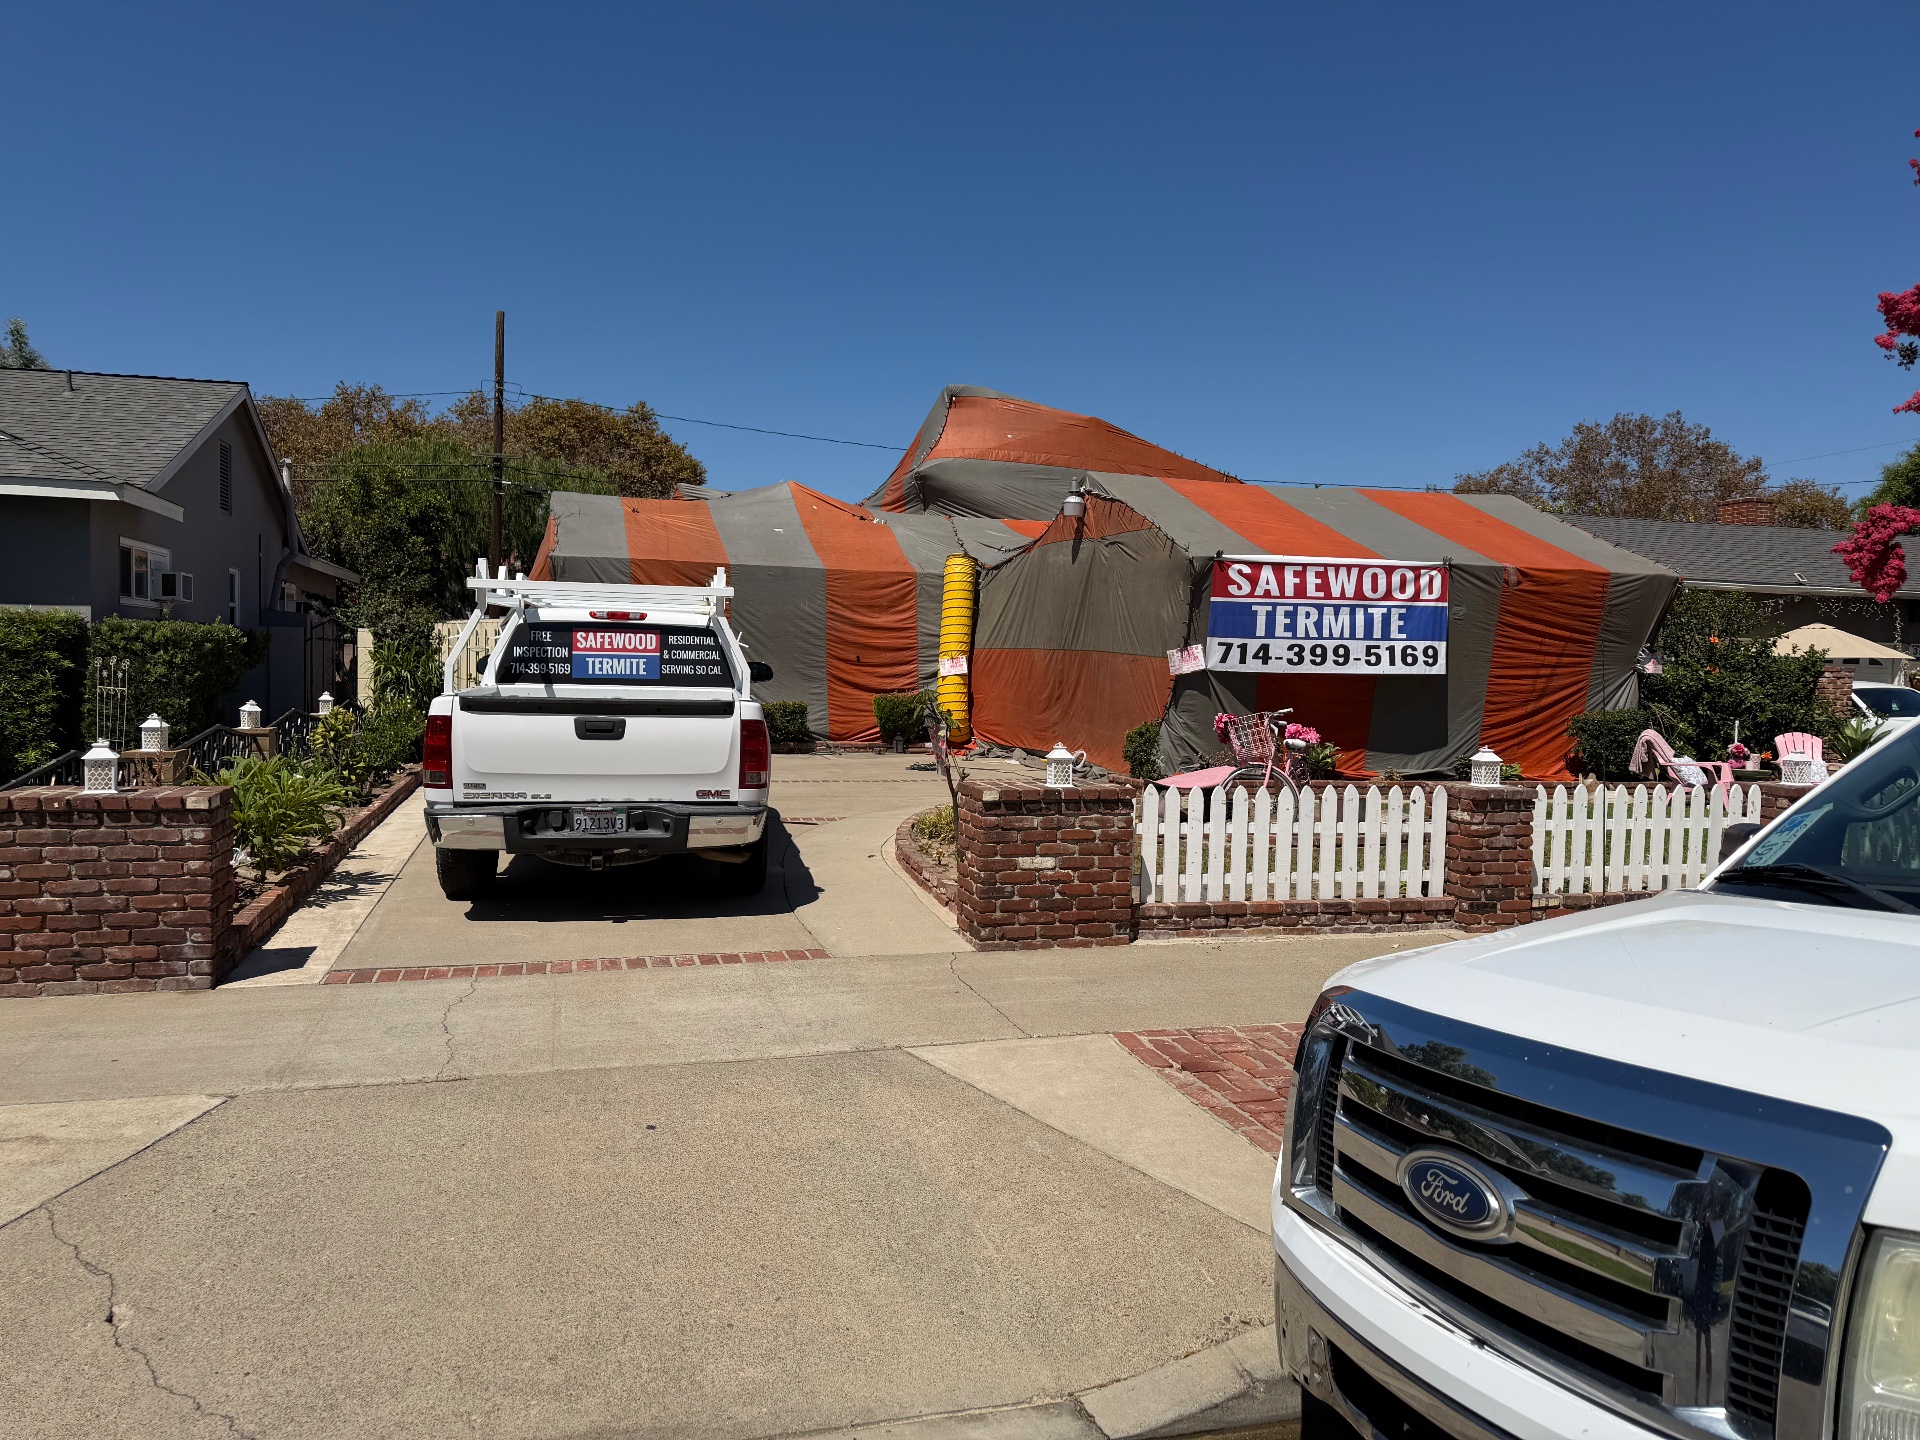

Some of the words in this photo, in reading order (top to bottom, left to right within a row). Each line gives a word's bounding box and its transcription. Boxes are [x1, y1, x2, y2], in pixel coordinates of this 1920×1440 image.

[1227, 563, 1442, 600] SAFEWOOD
[1252, 605, 1407, 639] TERMITE
[531, 630, 552, 642] FREE
[576, 631, 656, 650] SAFEWOOD
[668, 635, 715, 646] RESIDENTIAL
[513, 646, 568, 658] INSPECTION
[663, 650, 669, 659] &
[671, 650, 721, 660] COMMERCIAL
[1217, 641, 1439, 668] 714-399-5169
[510, 662, 571, 674] 714-399-5169
[586, 657, 647, 675] TERMITE
[661, 664, 694, 674] SERVING
[695, 665, 707, 675] SO
[708, 665, 723, 675] CAL
[696, 789, 730, 799] GMC
[575, 817, 624, 831] 91213V3
[1420, 1168, 1471, 1214] Ford
